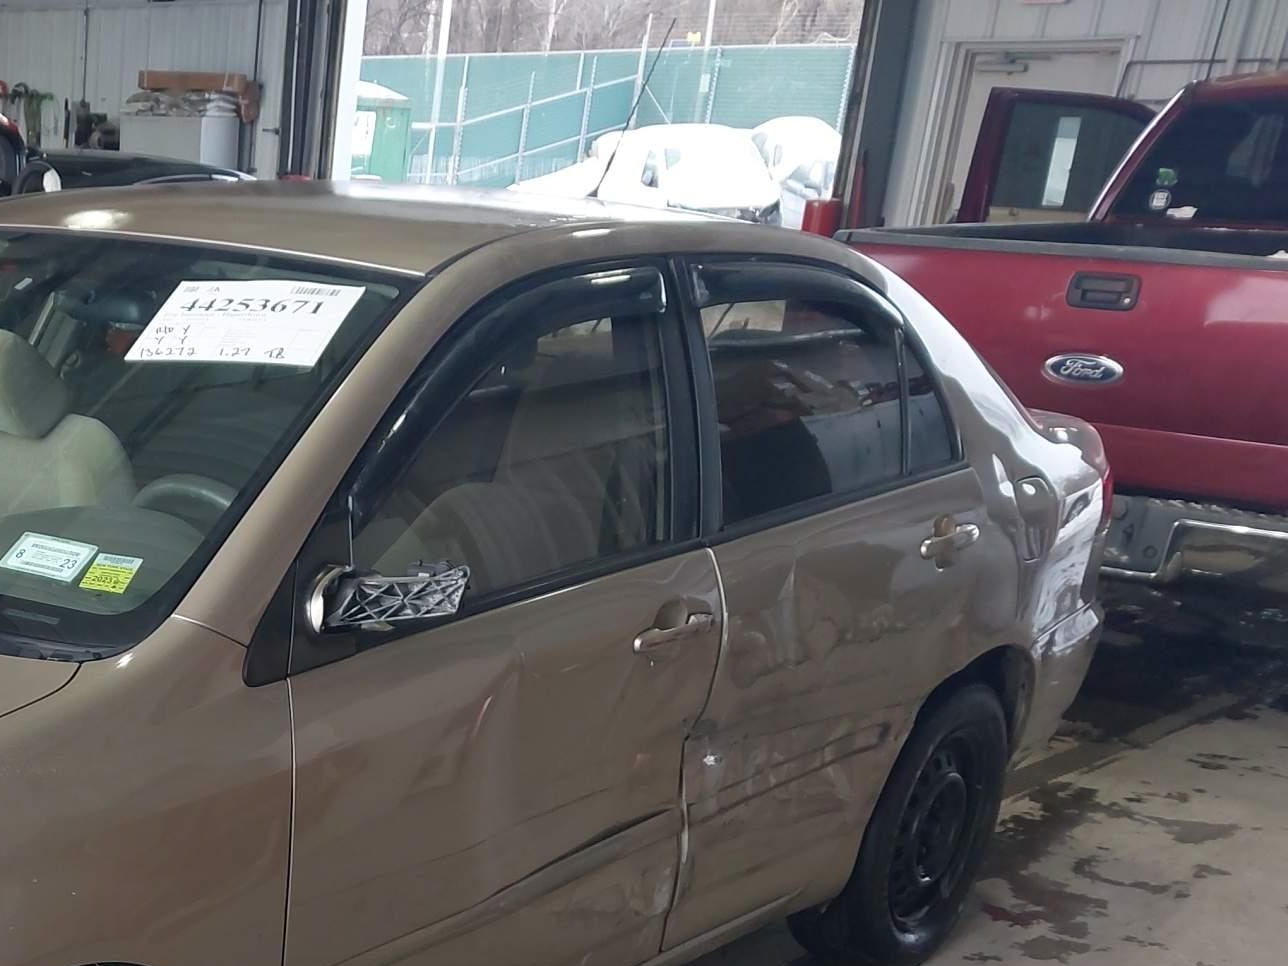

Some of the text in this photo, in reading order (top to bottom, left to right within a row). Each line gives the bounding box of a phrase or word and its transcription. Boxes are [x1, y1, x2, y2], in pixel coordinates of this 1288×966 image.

[180, 297, 324, 315] 44253671
[1059, 358, 1106, 379] Ford
[58, 558, 78, 570] 23
